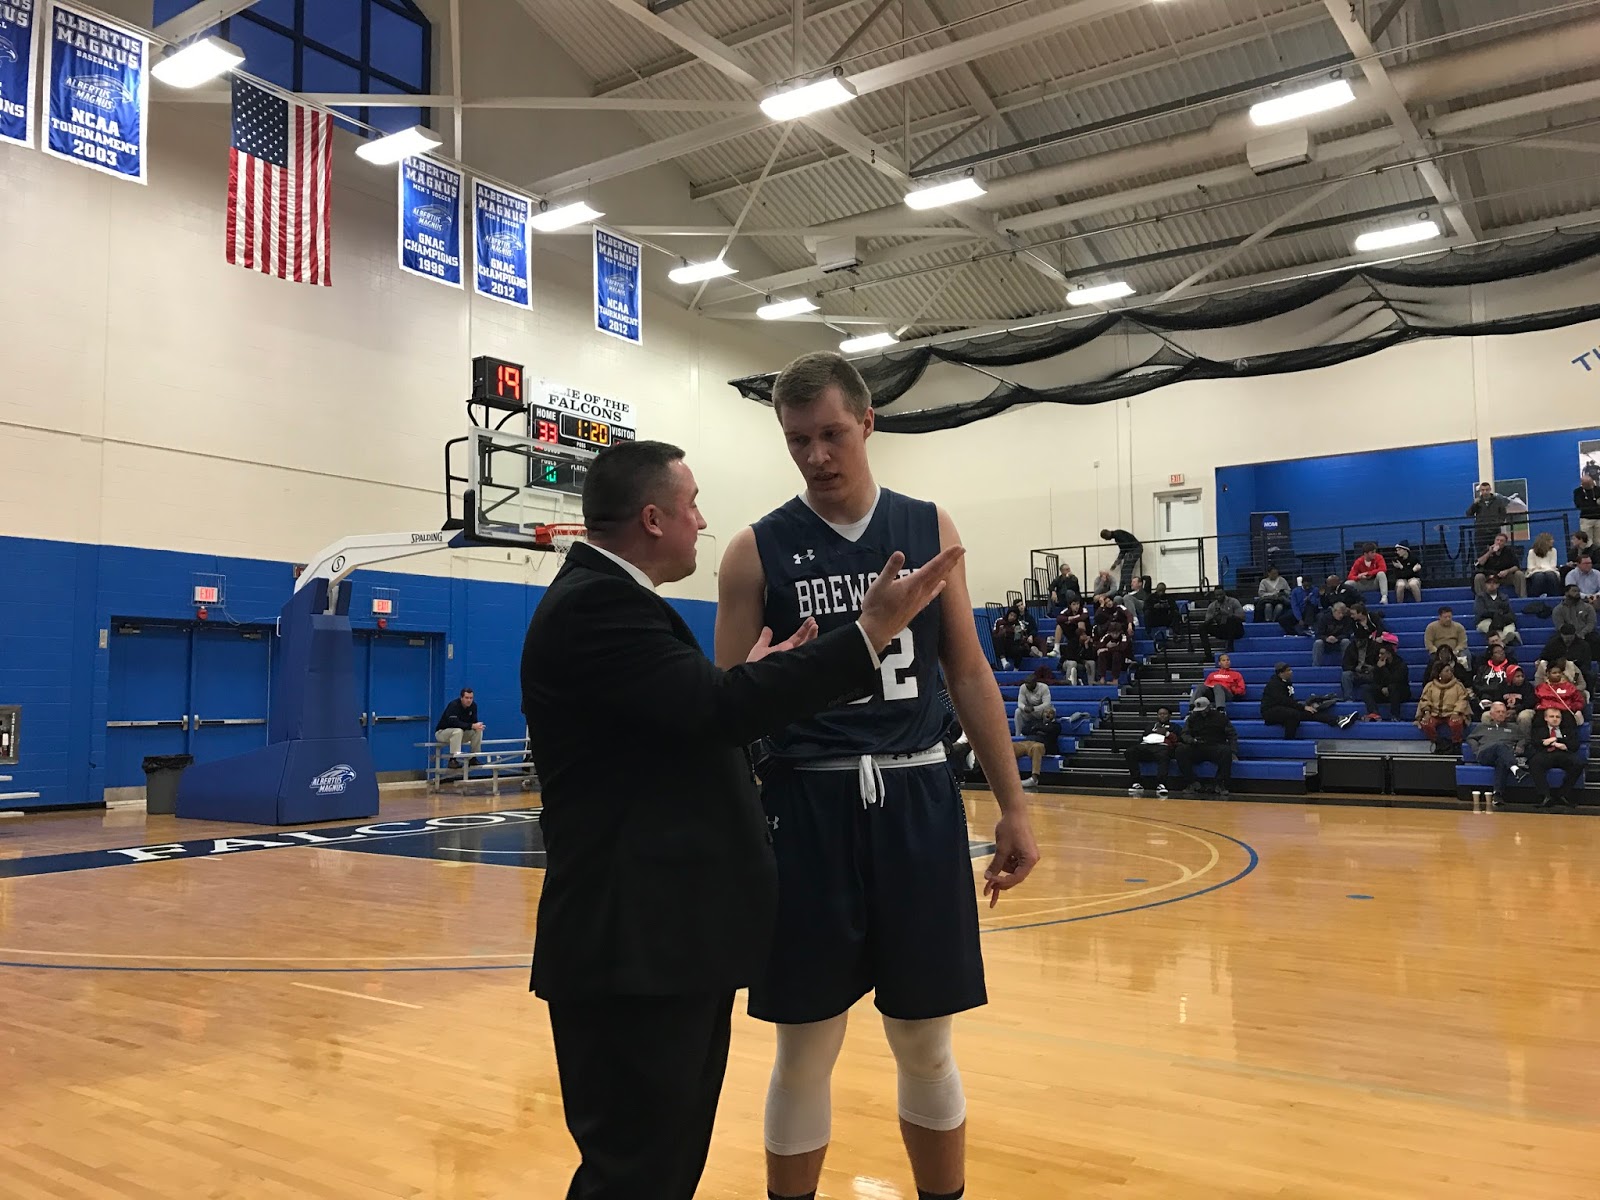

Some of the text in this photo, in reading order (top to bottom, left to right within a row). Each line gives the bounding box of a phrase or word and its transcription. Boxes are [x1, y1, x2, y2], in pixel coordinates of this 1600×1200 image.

[56, 11, 140, 53] ALBERTUS
[57, 26, 139, 69] MAGNUS
[76, 49, 119, 71] BASEBALL
[65, 77, 111, 99] ALBERTUS
[76, 89, 114, 110] MAGNUS
[71, 106, 120, 137] NCAA
[51, 117, 138, 155] TOURNAMENT
[73, 139, 118, 166] 2003
[405, 156, 459, 186] ALBERTUS
[405, 167, 457, 198] MAGNUS
[478, 185, 527, 212] ALBERTUS
[478, 196, 526, 224] MAGNUS
[404, 238, 459, 267] CHAMPIONS
[419, 232, 445, 252] GNAC
[598, 232, 638, 256] ALBERTUS
[490, 258, 515, 275] GNAC
[598, 243, 638, 267] MAGNUS
[418, 257, 445, 277] 1996
[478, 264, 527, 289] CHAMPIONS
[491, 281, 515, 299] 2012
[598, 304, 639, 327] TOURNAMENT
[607, 296, 629, 315] NCAA
[608, 318, 628, 335] 2012
[498, 365, 520, 400] 19
[536, 407, 557, 421] HOME
[548, 394, 622, 422] FALCONS
[583, 393, 601, 404] OF
[603, 398, 630, 413] THE
[538, 419, 558, 444] 33
[577, 419, 608, 444] 1:20
[611, 426, 635, 440] VISITOR
[410, 532, 443, 544] SPALDING
[200, 588, 215, 600] EXIT
[311, 776, 343, 786] ALBERTUS
[318, 784, 344, 793] MAGNUS
